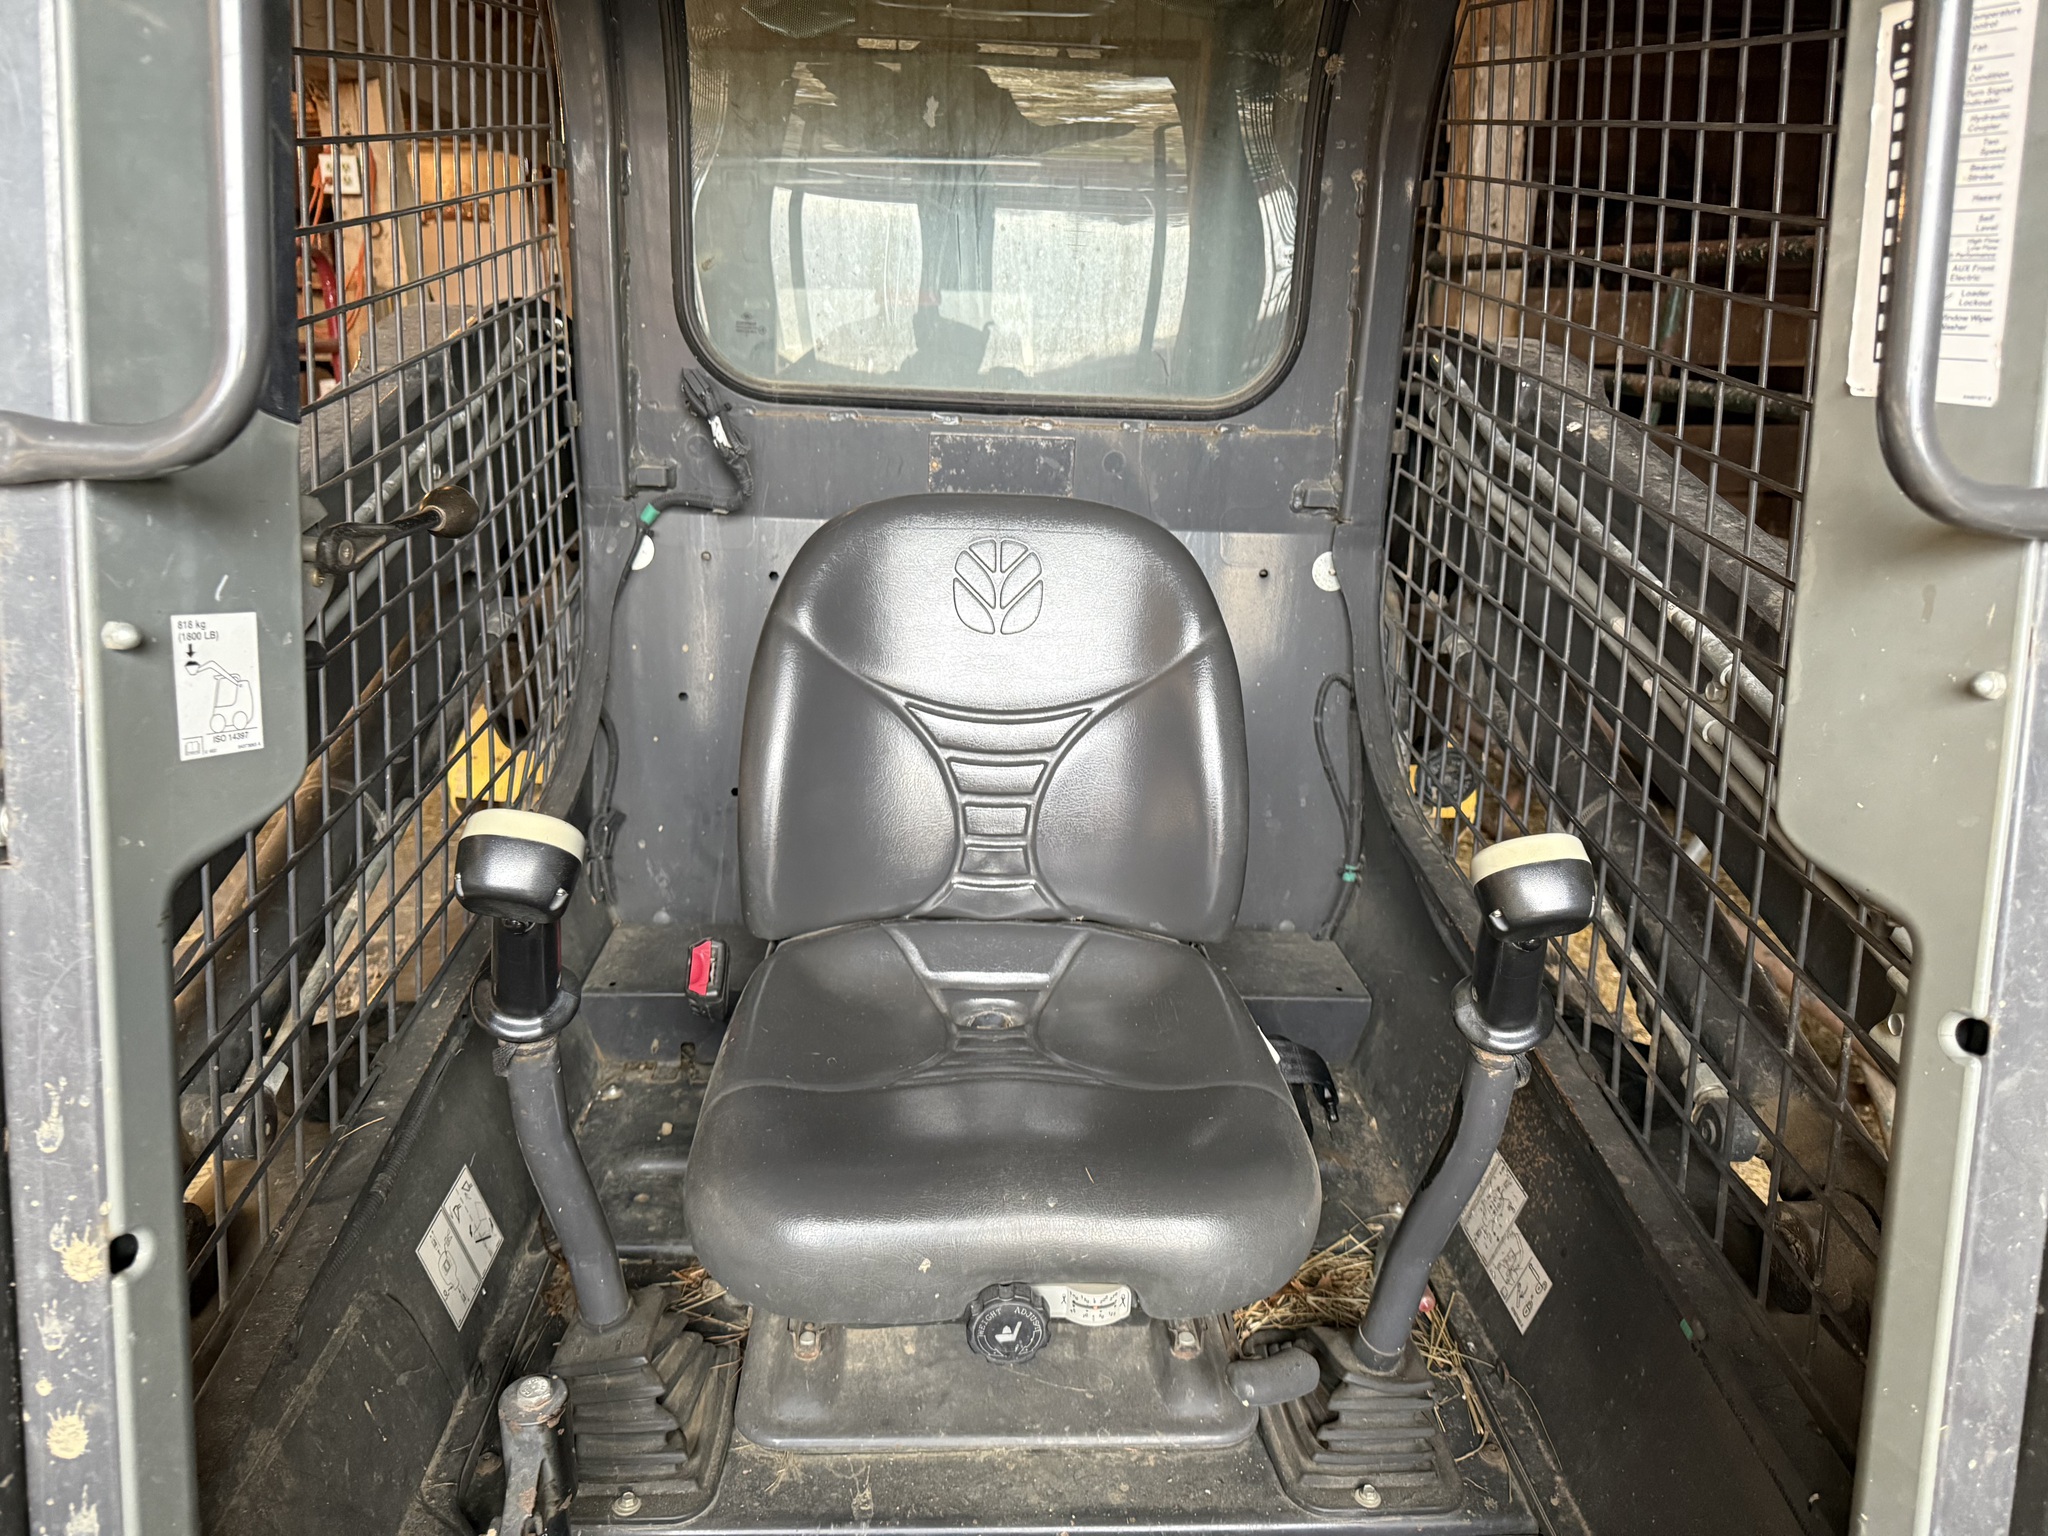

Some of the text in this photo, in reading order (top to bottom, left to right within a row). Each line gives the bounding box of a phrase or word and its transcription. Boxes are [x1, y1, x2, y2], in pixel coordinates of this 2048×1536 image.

[1973, 6, 2022, 20] emperature
[1973, 19, 1998, 30] ontrol
[1952, 264, 1995, 272] AUX Front
[1950, 274, 1980, 282] Electric
[1961, 290, 1990, 298] Loader
[1959, 299, 1993, 307] Lockout
[1970, 314, 1993, 323] Wiper
[177, 619, 206, 631] 818 kg
[178, 630, 219, 644] (1800 LB)
[213, 731, 249, 743] ISO 14397
[977, 1308, 1002, 1337] WEIGHT
[1014, 1306, 1041, 1333] ADJUST
